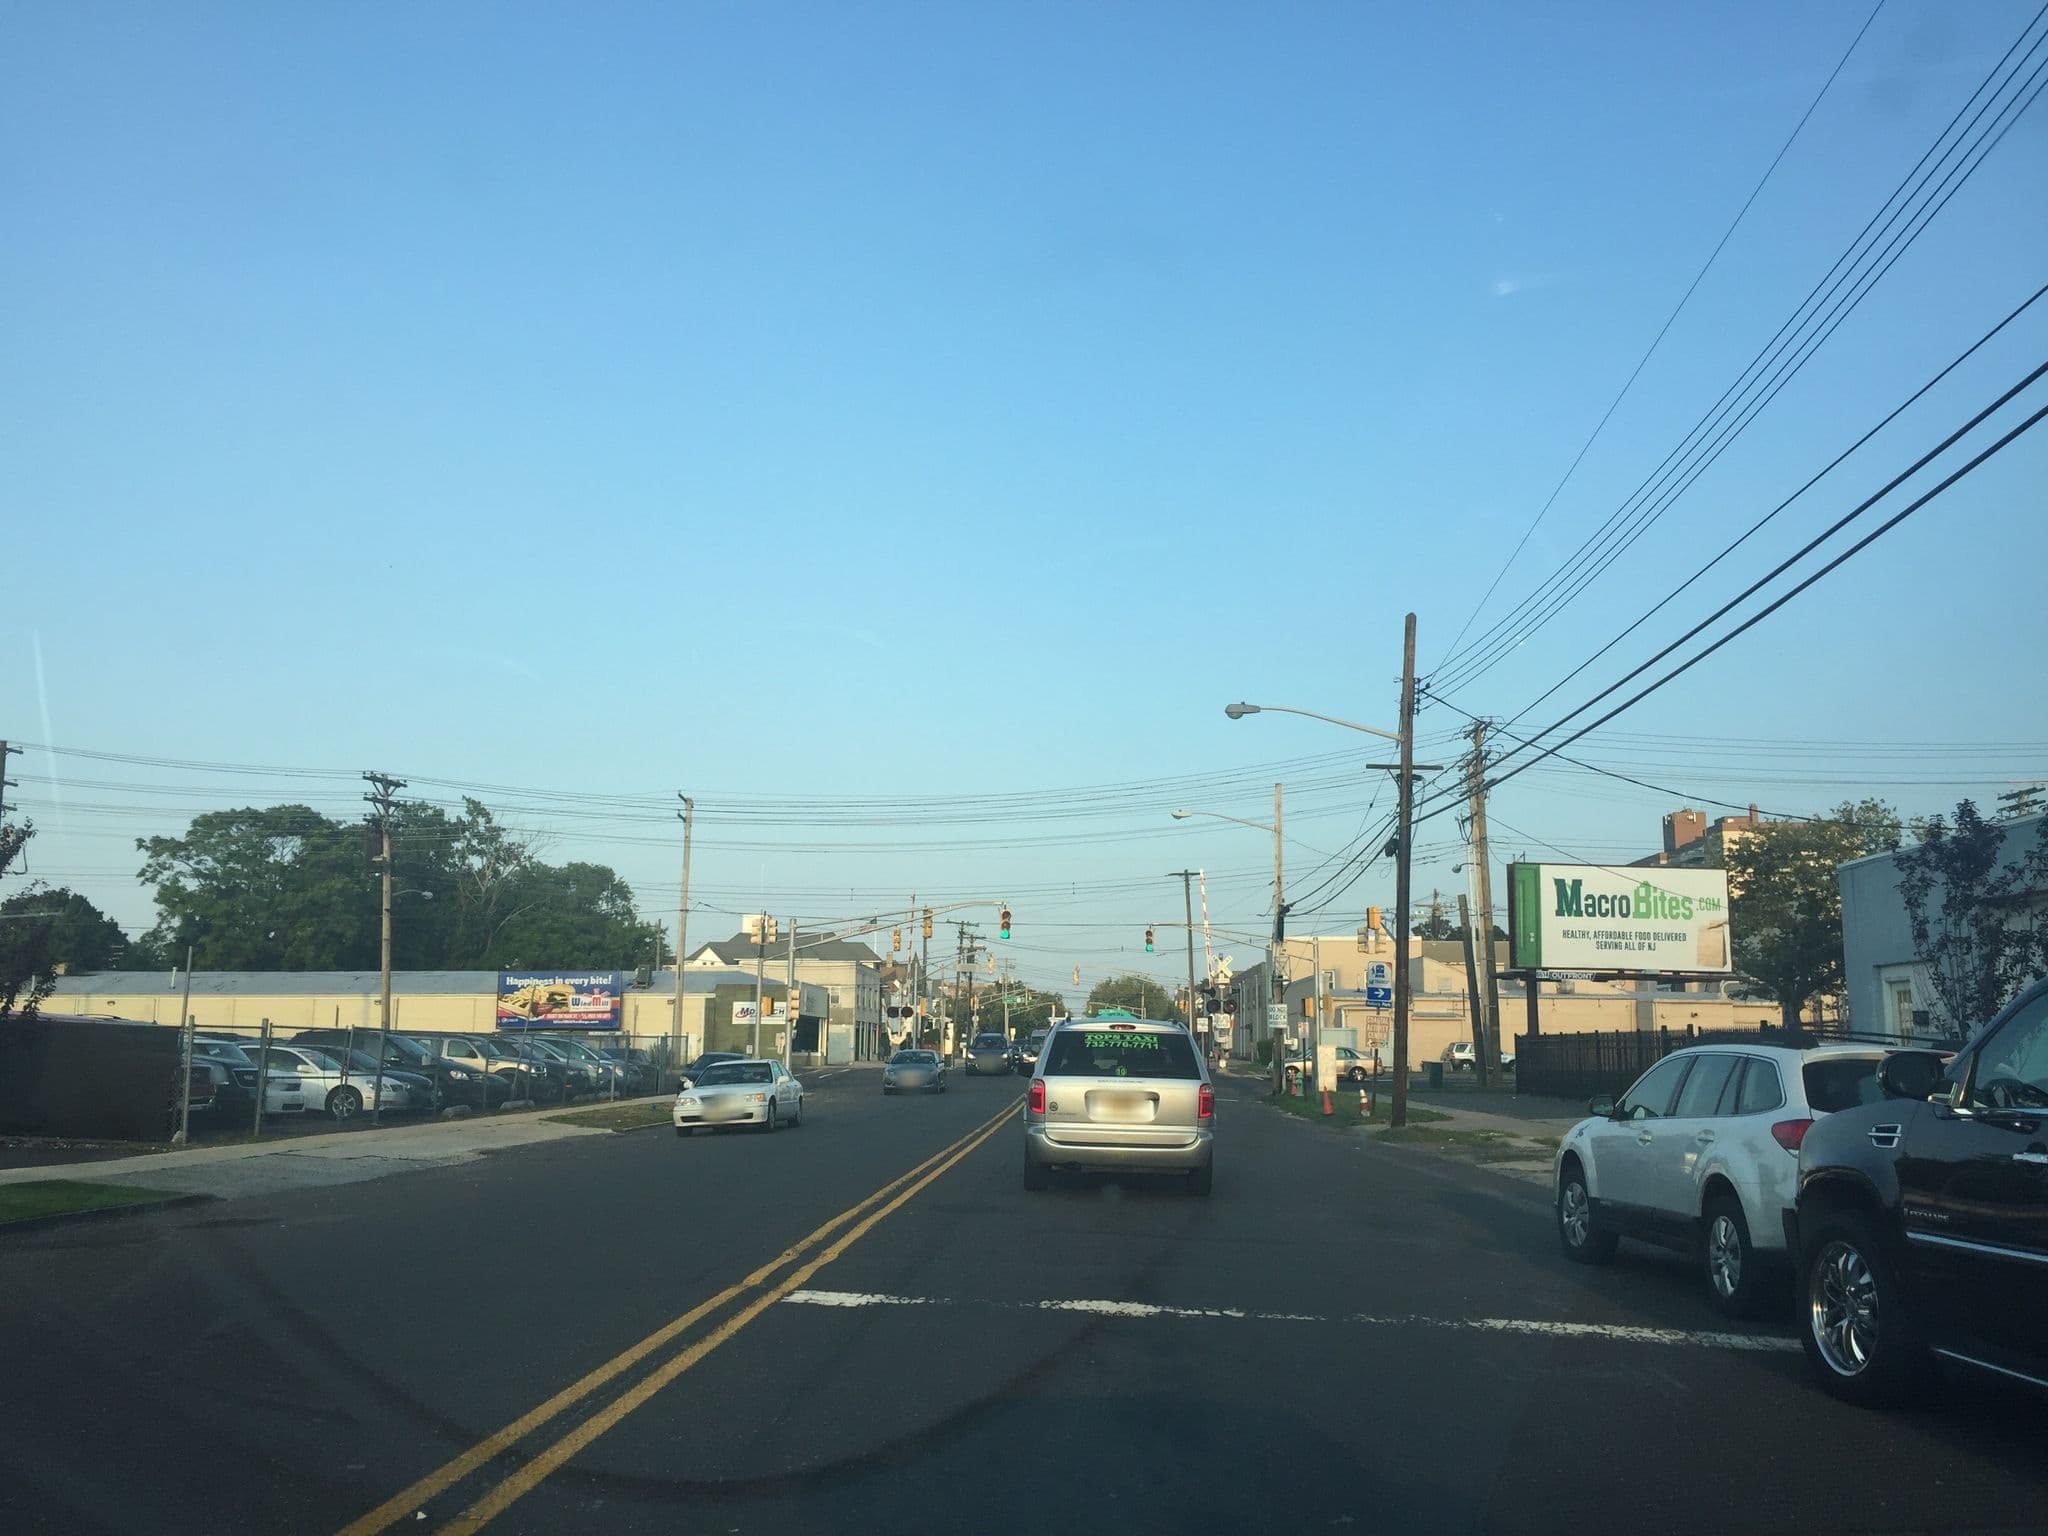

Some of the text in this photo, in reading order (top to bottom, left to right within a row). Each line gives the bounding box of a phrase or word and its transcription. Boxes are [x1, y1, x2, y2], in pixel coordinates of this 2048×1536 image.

[1562, 929, 1687, 942] HEALTHY, AFFORDABLE FOOD DELIVERED
[1595, 941, 1656, 951] SERVING ALL OF NJ
[506, 975, 612, 988] Happiness in every bite!
